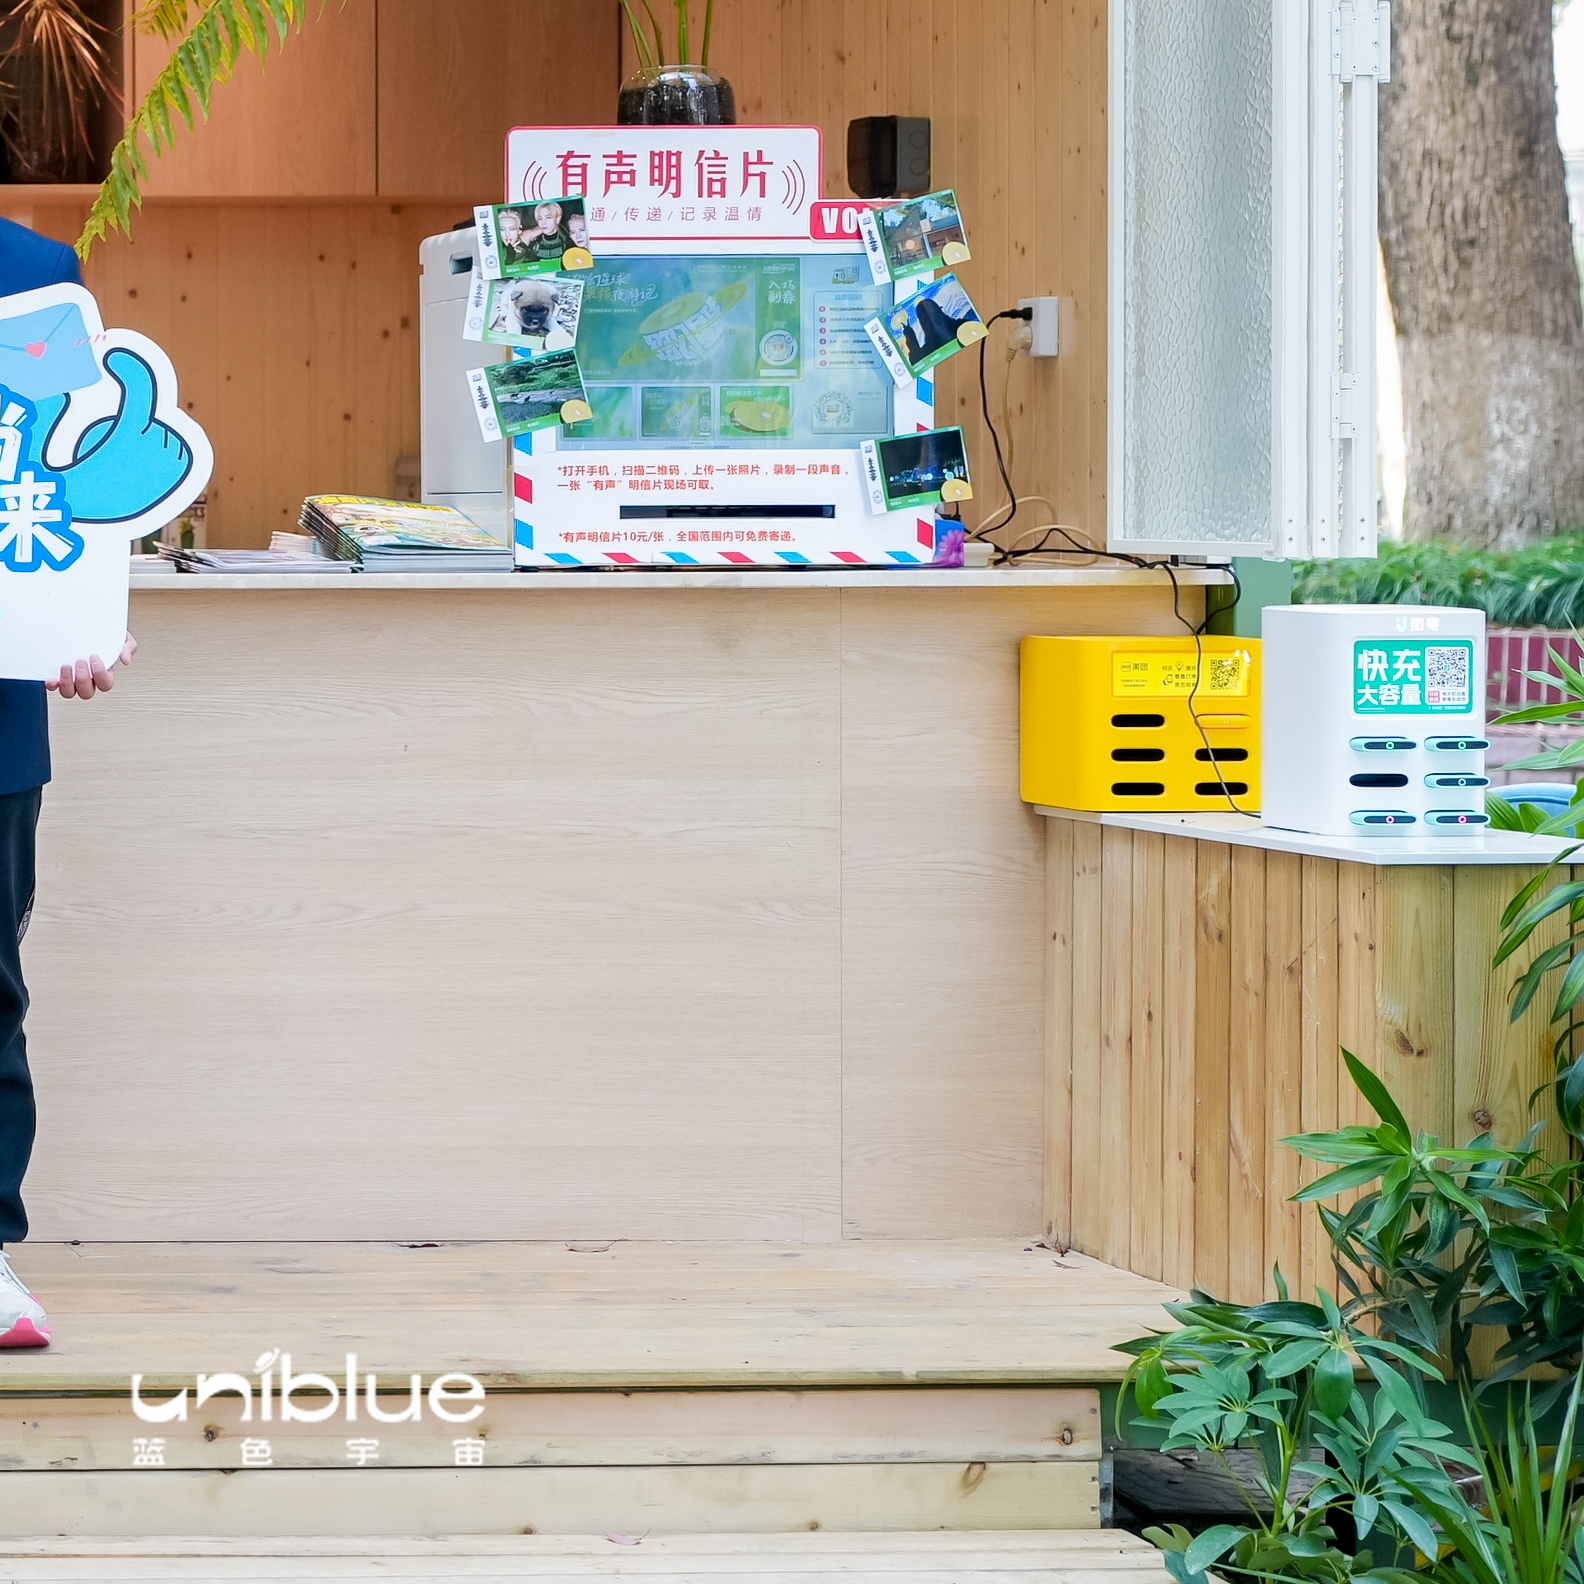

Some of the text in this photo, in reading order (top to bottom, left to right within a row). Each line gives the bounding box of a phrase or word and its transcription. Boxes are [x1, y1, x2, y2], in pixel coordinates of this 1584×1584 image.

[555, 149, 775, 200] 有声明信片
[1357, 648, 1422, 682] 快充
[1357, 683, 1422, 705] 大容量
